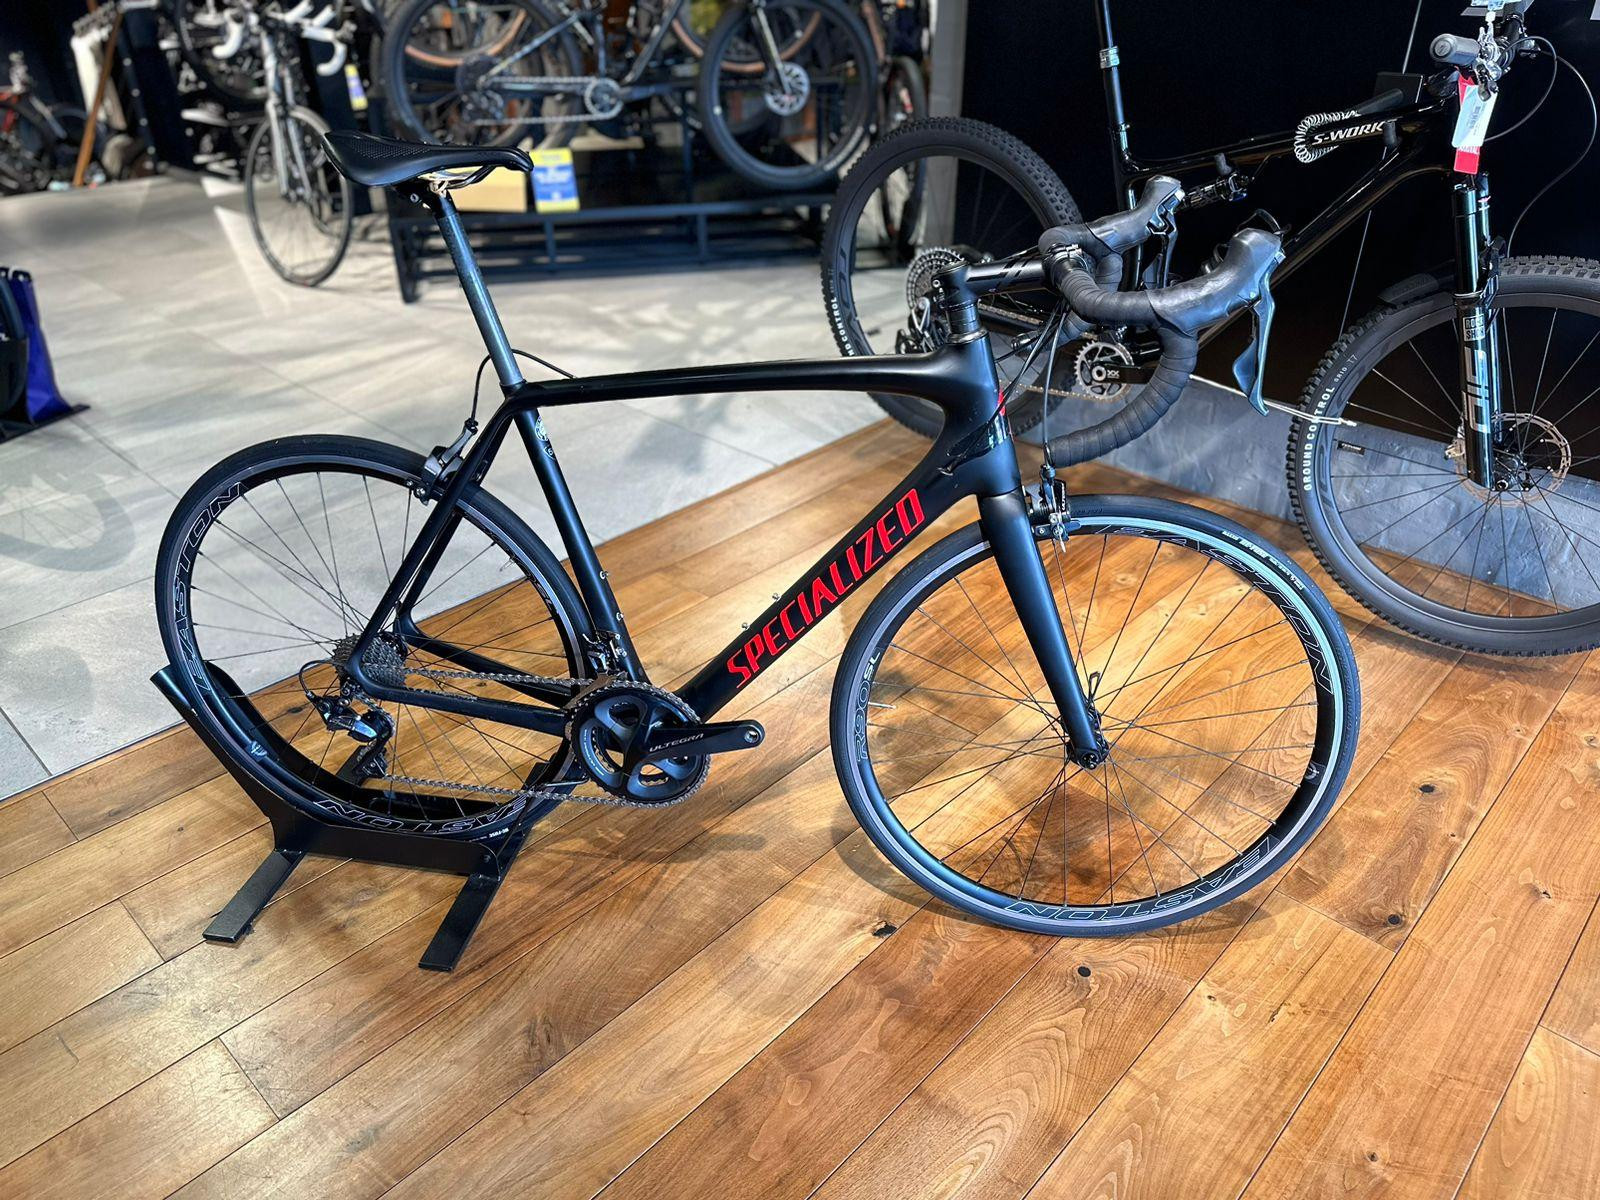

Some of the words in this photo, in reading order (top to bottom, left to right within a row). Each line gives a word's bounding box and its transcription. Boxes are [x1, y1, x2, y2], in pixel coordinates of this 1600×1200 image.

[830, 296, 849, 342] CONTROL
[1306, 385, 1336, 440] COTROL
[1302, 442, 1313, 491] GROUND
[173, 481, 249, 691] EASTON
[726, 488, 926, 689] SPECIALIZED
[1095, 524, 1334, 695] EASTON
[649, 732, 704, 752] ULTEGRA
[312, 792, 528, 835] EASTON
[1004, 834, 1281, 921] EASTON
